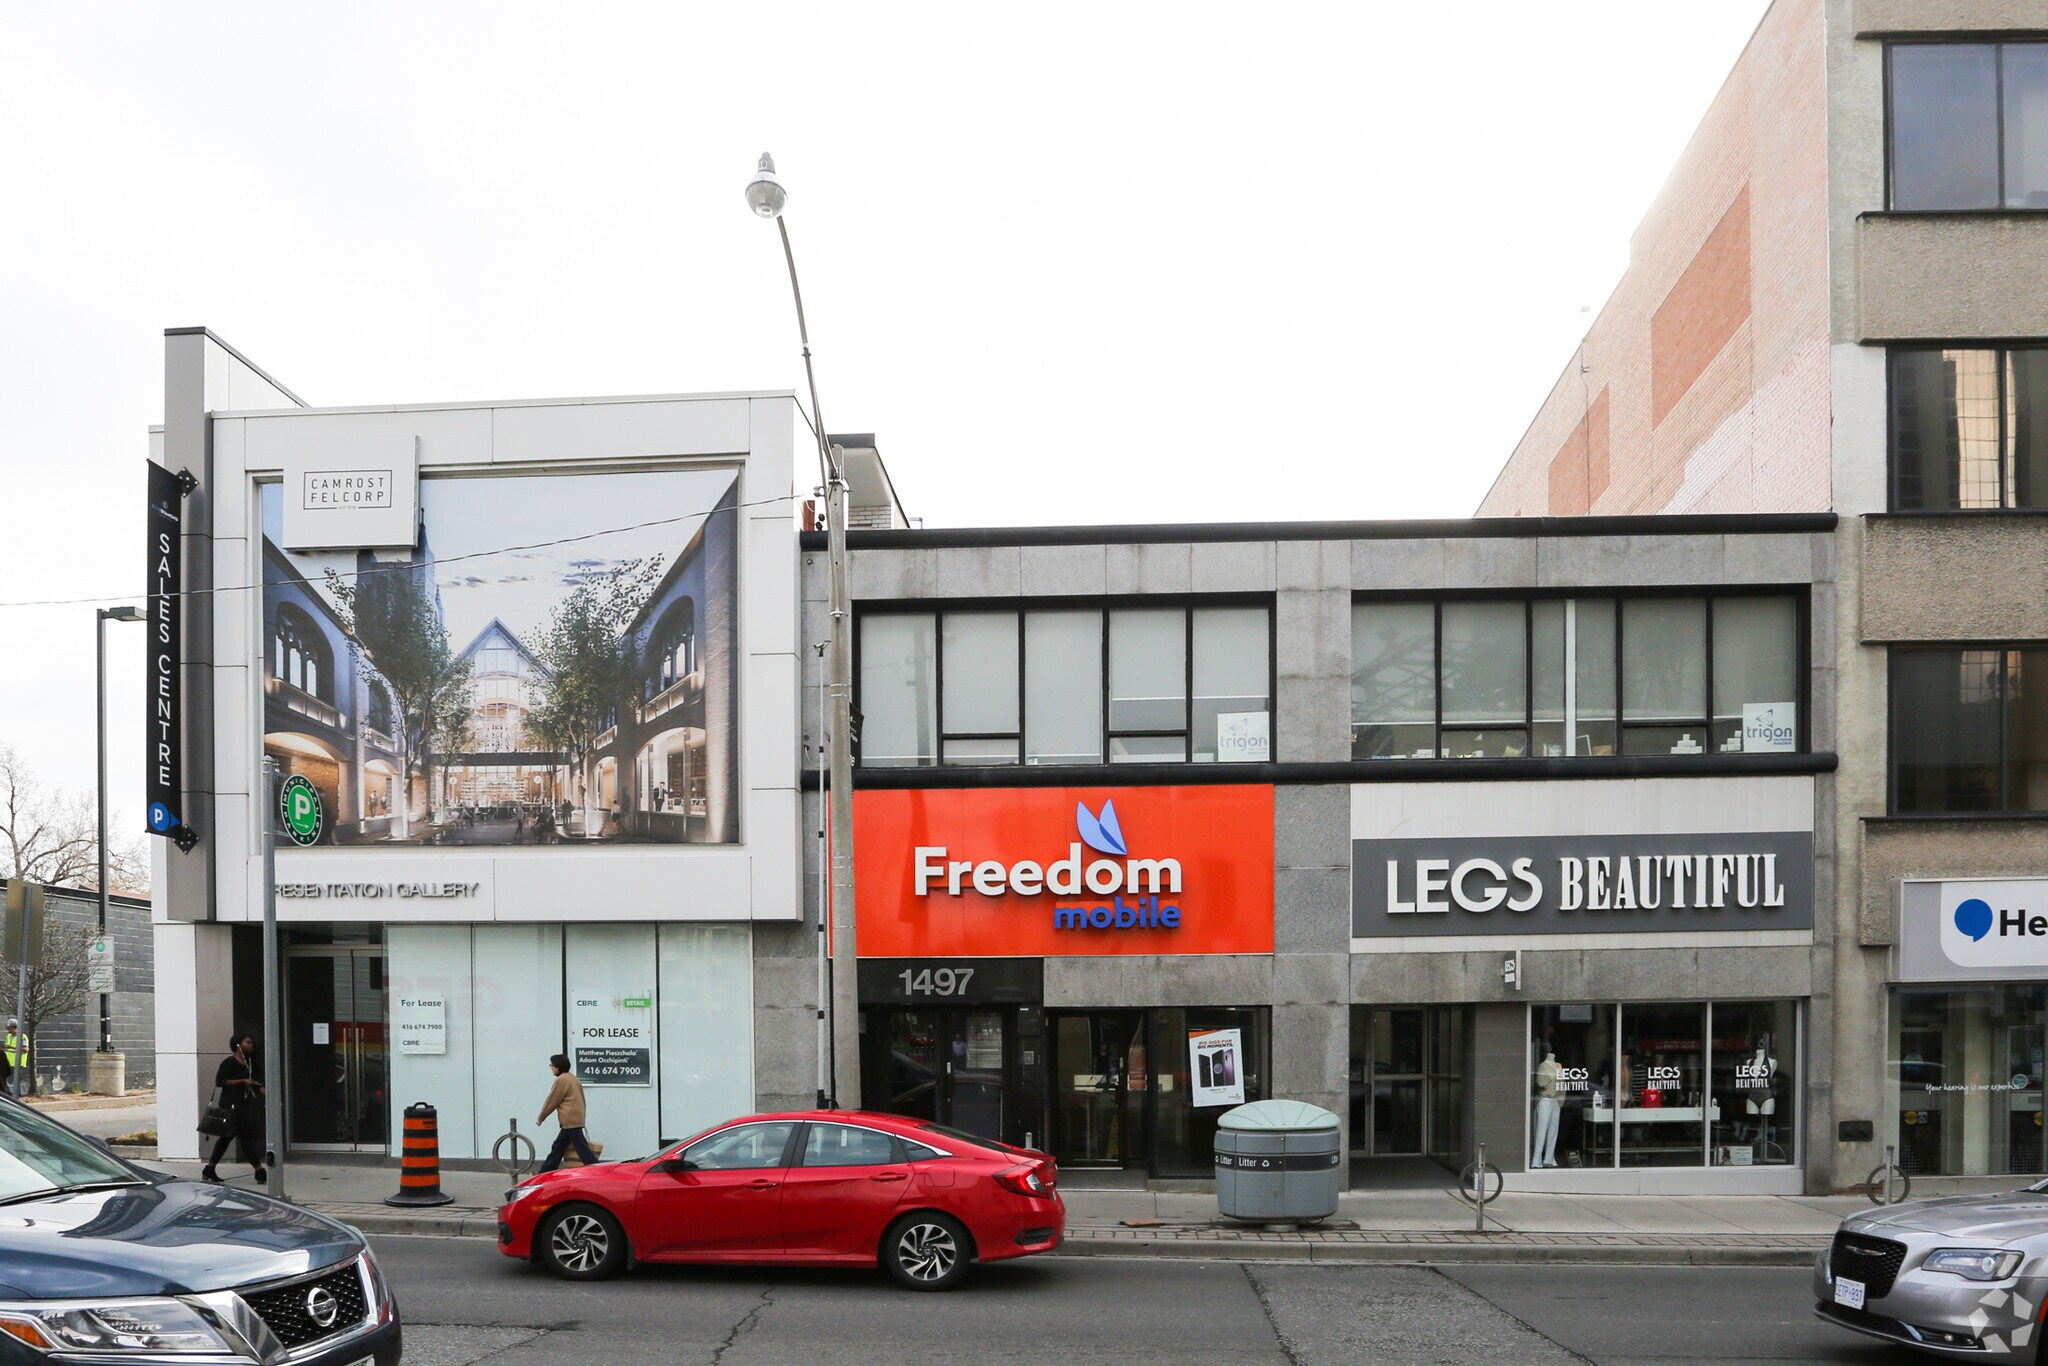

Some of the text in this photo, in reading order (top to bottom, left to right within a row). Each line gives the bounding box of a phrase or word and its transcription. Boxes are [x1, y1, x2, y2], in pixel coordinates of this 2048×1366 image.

[311, 478, 384, 489] CAMROST
[311, 491, 384, 502] FELCORP
[158, 533, 171, 786] SALES CENTRE
[1746, 724, 1792, 742] trigon
[1220, 733, 1267, 751] trigon
[294, 793, 310, 820] P
[914, 842, 1182, 896] Freedom
[1387, 857, 1543, 914] LEGS
[1558, 853, 1785, 911] BEAUTIFUL
[274, 882, 479, 898] RESENTATION GALLERY
[1054, 896, 1180, 929] mobile
[2000, 909, 2048, 936] He
[898, 968, 974, 996] 1497
[583, 1028, 639, 1037] FOR LEASE
[1556, 1068, 1588, 1080] LEGS
[1648, 1067, 1680, 1079] LEGS
[1736, 1066, 1768, 1077] LEGS
[1556, 1082, 1589, 1091] BEAUTIFUL
[1648, 1080, 1680, 1090] BEAUTIFUL
[1736, 1079, 1769, 1088] BEAUTIFUL
[1925, 1084, 1942, 1094] Your
[1944, 1083, 1968, 1095] hearing
[1991, 1082, 2020, 1091] expertise
[1220, 1156, 1232, 1165] Litter
[1238, 1157, 1256, 1167] Litter
